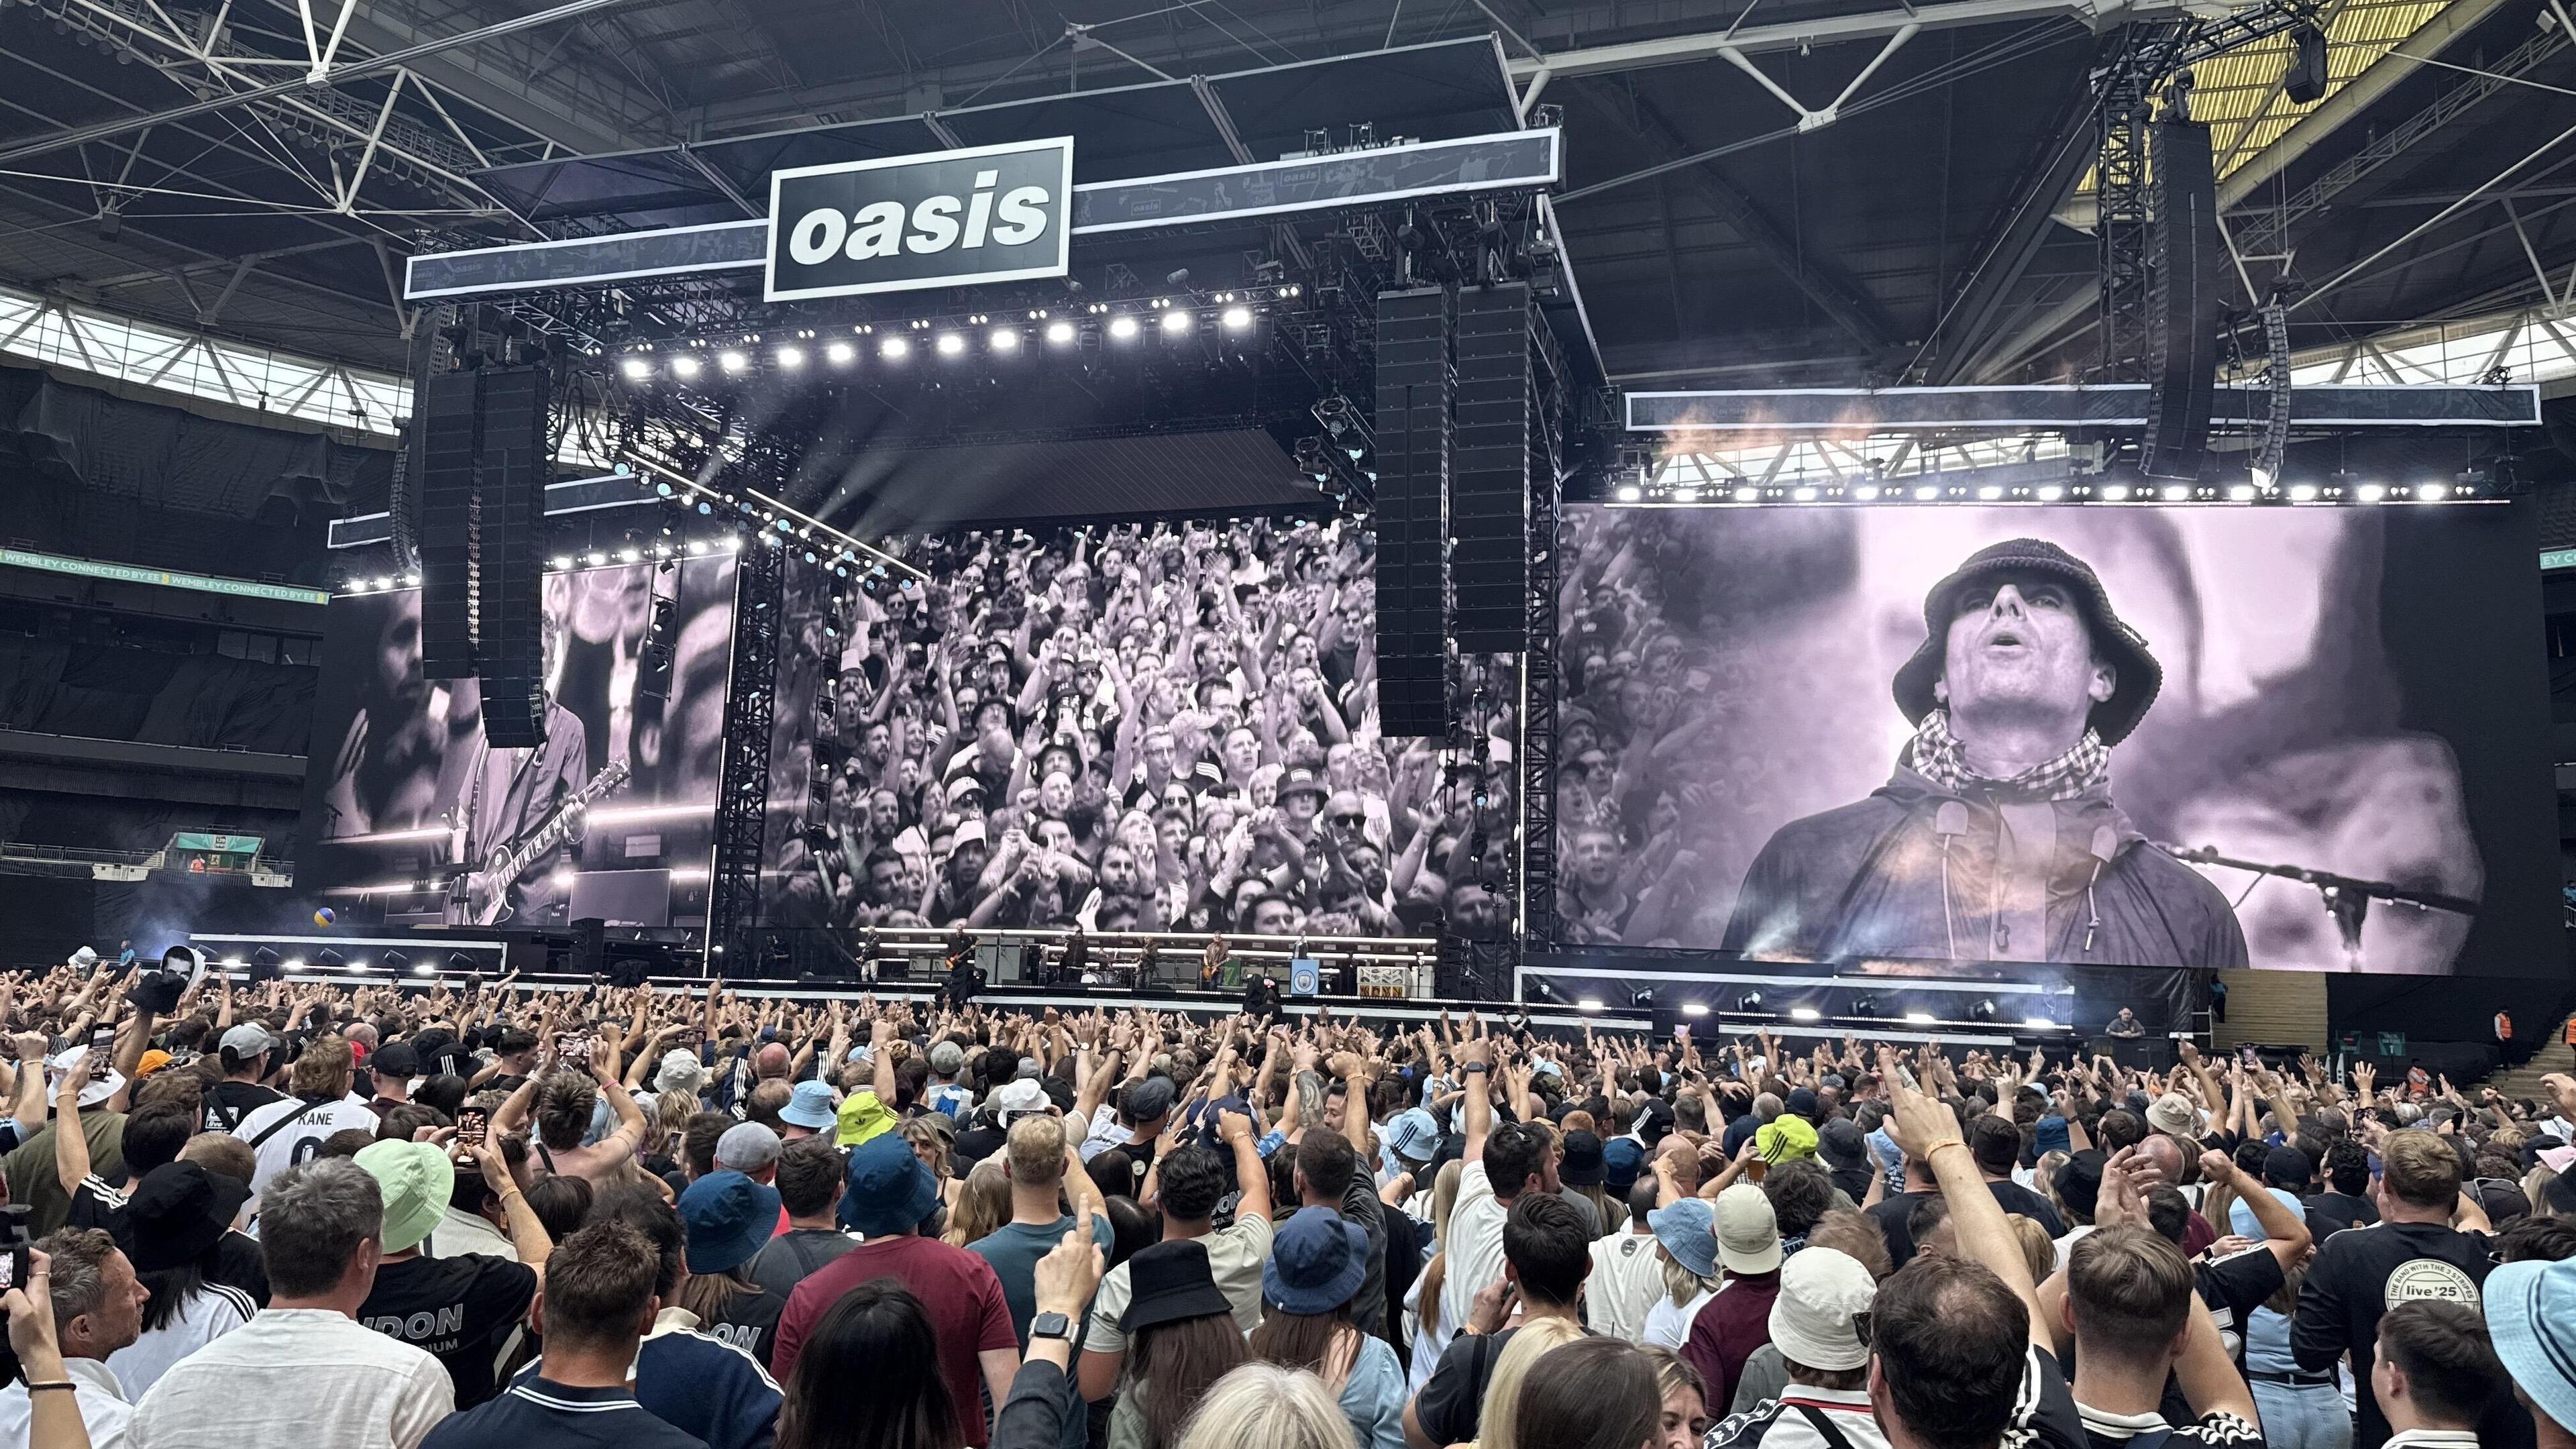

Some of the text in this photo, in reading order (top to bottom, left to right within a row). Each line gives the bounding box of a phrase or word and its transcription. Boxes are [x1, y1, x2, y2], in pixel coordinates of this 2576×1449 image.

[790, 170, 1049, 266] oasis
[5, 553, 160, 582] WEMBLEY CONNECTED BY EE
[2543, 554, 2561, 566] EY
[172, 576, 316, 601] WEMBLEY CONNECTED BY EE
[298, 1112, 334, 1126] KANE
[2395, 1268, 2410, 1283] BAND
[2409, 1263, 2429, 1272] WITH
[2430, 1263, 2445, 1272] THE
[2451, 1272, 2475, 1299] STRIPES
[2406, 1285, 2432, 1296] live
